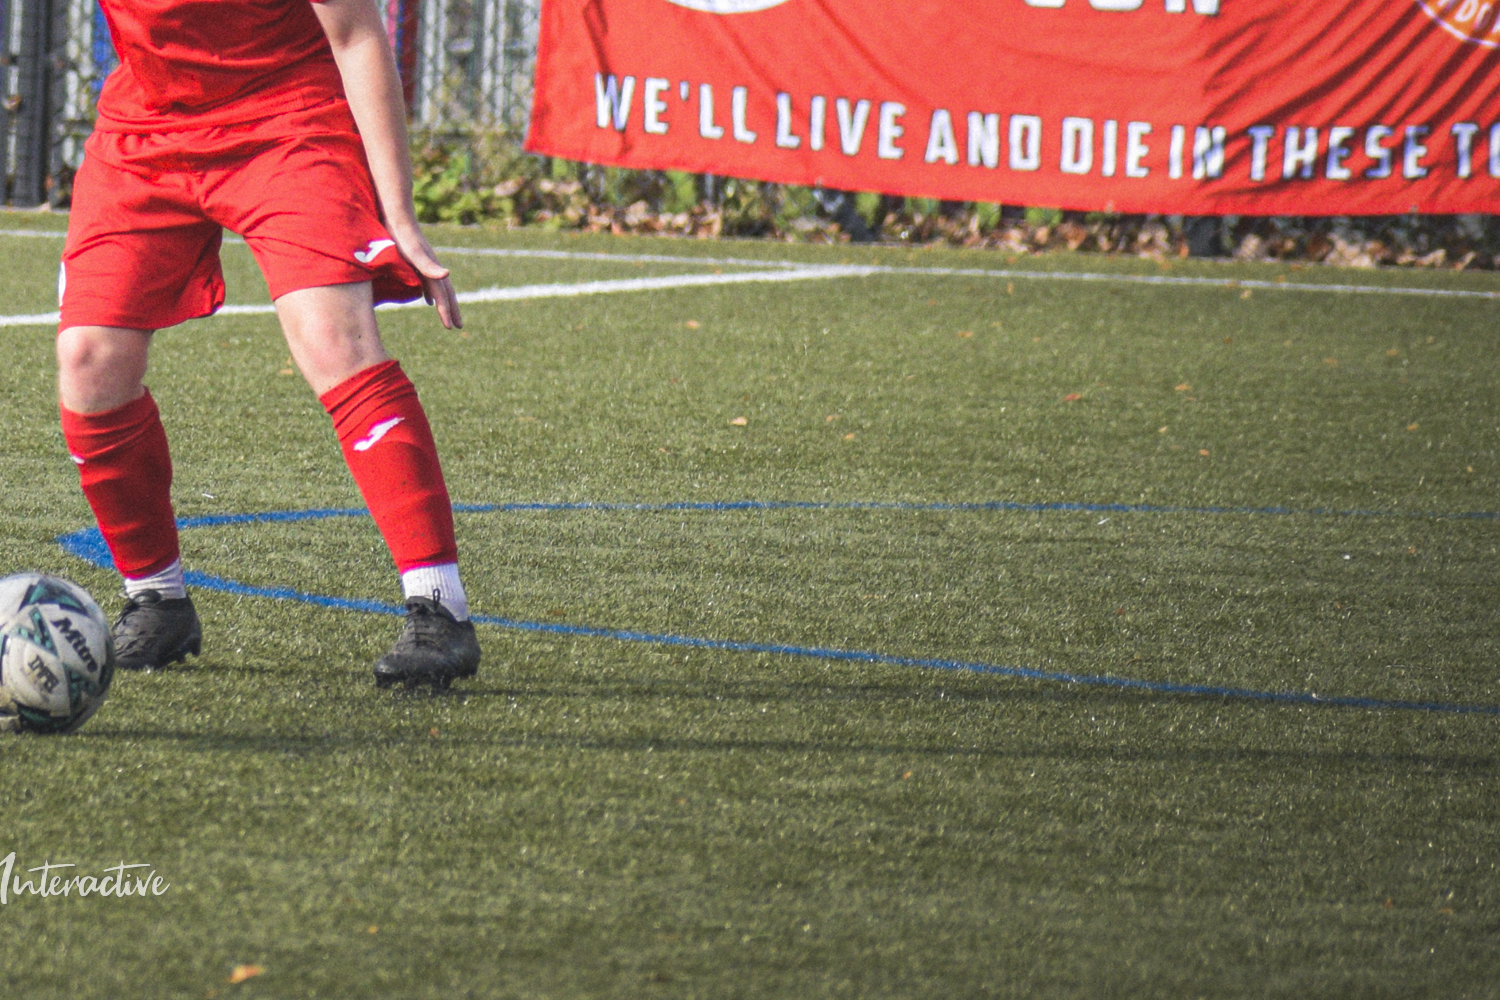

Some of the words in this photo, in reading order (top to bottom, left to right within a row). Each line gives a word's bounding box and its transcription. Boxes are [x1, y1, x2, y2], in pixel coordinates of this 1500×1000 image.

[594, 72, 756, 144] WE'LL
[776, 92, 906, 160] LIVE
[924, 109, 1041, 170] AND
[1059, 116, 1152, 178] DIE
[1169, 125, 1226, 180] IN
[1248, 124, 1429, 181] THESE
